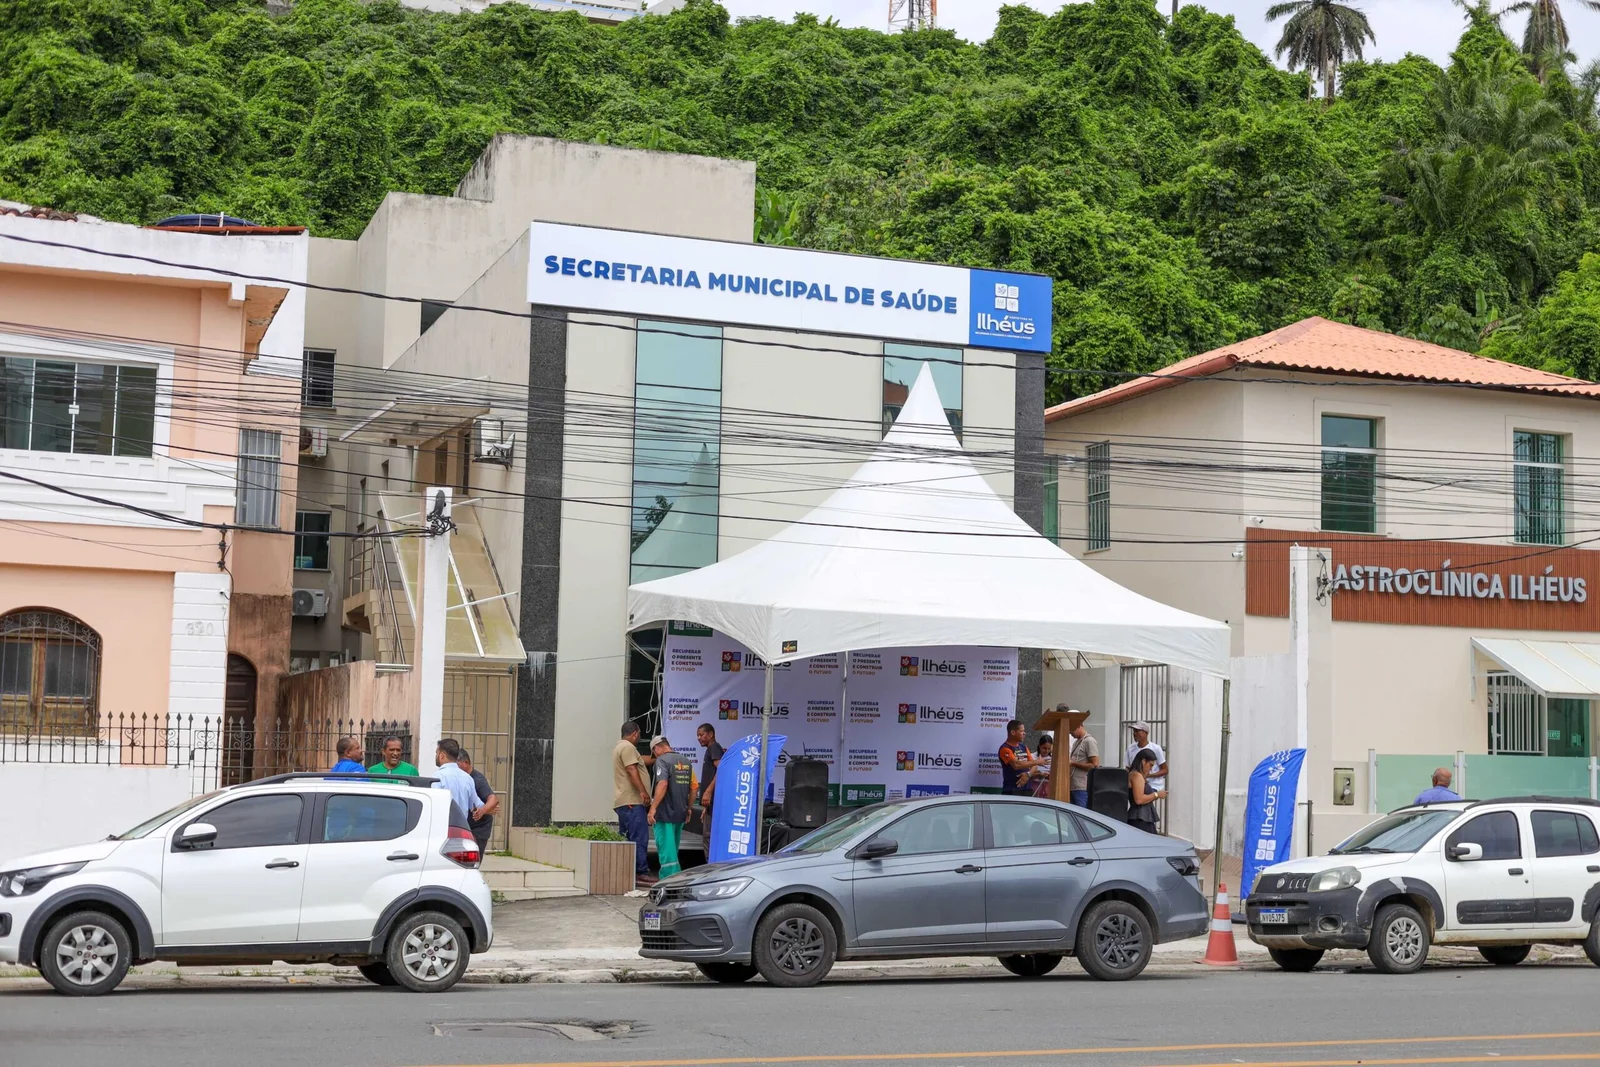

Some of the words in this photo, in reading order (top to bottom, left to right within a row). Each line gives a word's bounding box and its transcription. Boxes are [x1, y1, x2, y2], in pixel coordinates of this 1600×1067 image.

[544, 255, 702, 289] SECRETARIA
[708, 272, 838, 302] MUNICIPAL
[845, 286, 874, 305] DE
[880, 289, 957, 314] SAÚDE
[977, 312, 1036, 334] Ilhéus
[1334, 559, 1505, 600] ASTROCLÍNICA
[1509, 565, 1587, 603] ILHÉUS
[922, 659, 966, 674] Ilhéus
[920, 706, 964, 720] Ilhéus
[918, 753, 962, 767] Ilhéus
[733, 772, 750, 827] Ilhéus
[859, 790, 882, 798] Ilhéus
[1261, 785, 1276, 836] Ilhéus
